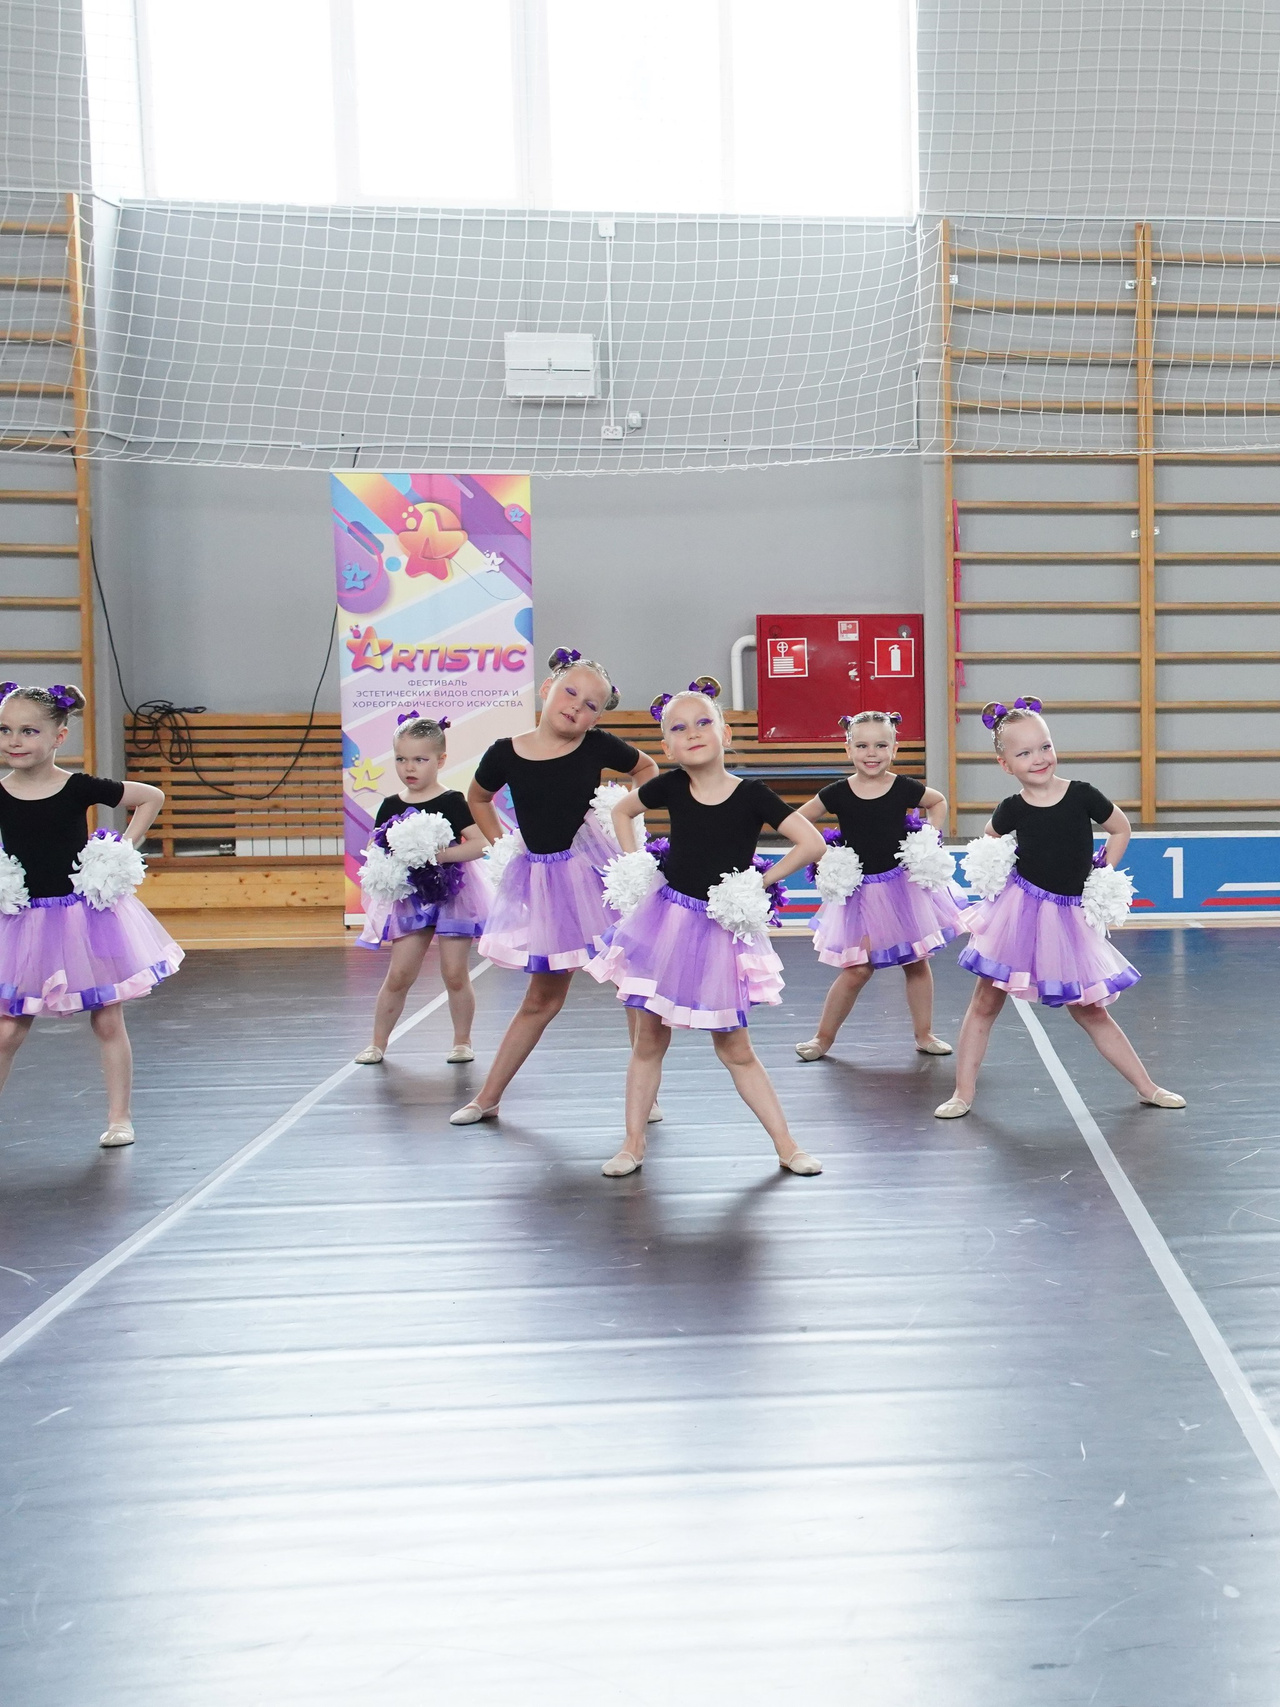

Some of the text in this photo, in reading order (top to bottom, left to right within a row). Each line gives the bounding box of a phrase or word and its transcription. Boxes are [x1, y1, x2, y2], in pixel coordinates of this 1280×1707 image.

[345, 624, 527, 672] ARTISTIC
[407, 679, 468, 687] ФЕСТИВАЛЬ
[356, 690, 431, 698] ЭСТЕТИЧЕСКИХ
[433, 690, 469, 698] ВИДОВ
[512, 689, 519, 697] И
[352, 700, 524, 708] ХОРЕОГРАФИЧЕСКОГО ИСКУССТВА
[1162, 847, 1184, 899] 1
